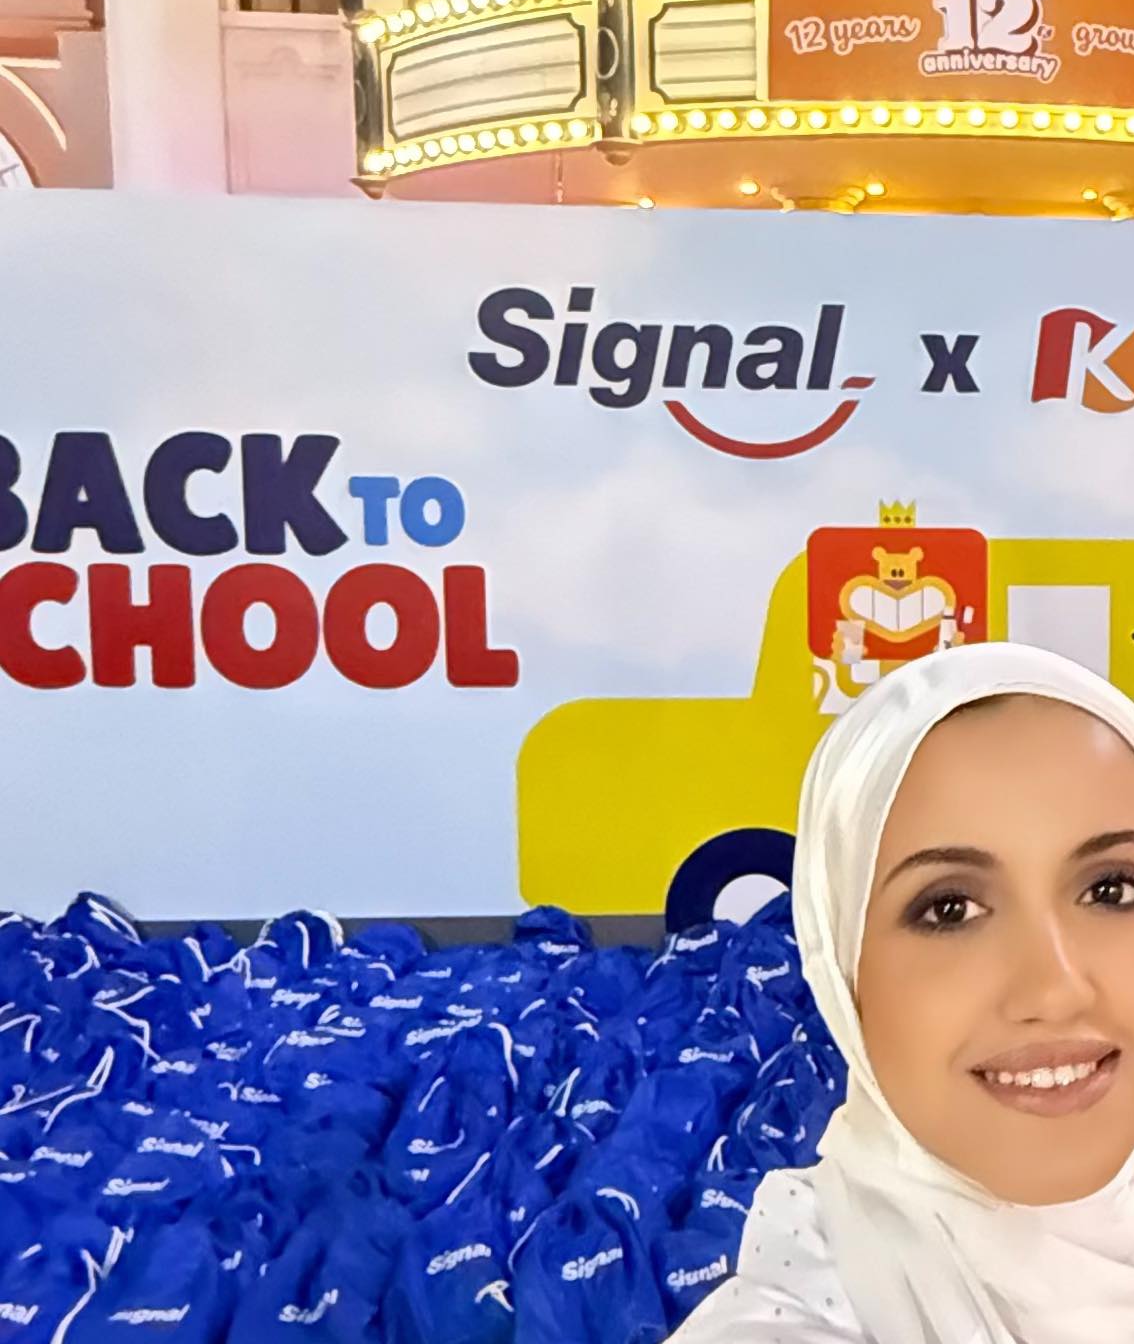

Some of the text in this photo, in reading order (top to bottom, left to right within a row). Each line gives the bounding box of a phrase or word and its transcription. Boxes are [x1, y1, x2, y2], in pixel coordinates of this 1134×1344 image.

[787, 17, 919, 53] 12 years
[922, 52, 1057, 81] anniversary
[467, 286, 847, 408] Signal
[349, 476, 465, 548] TO
[107, 1304, 190, 1325] gnal
